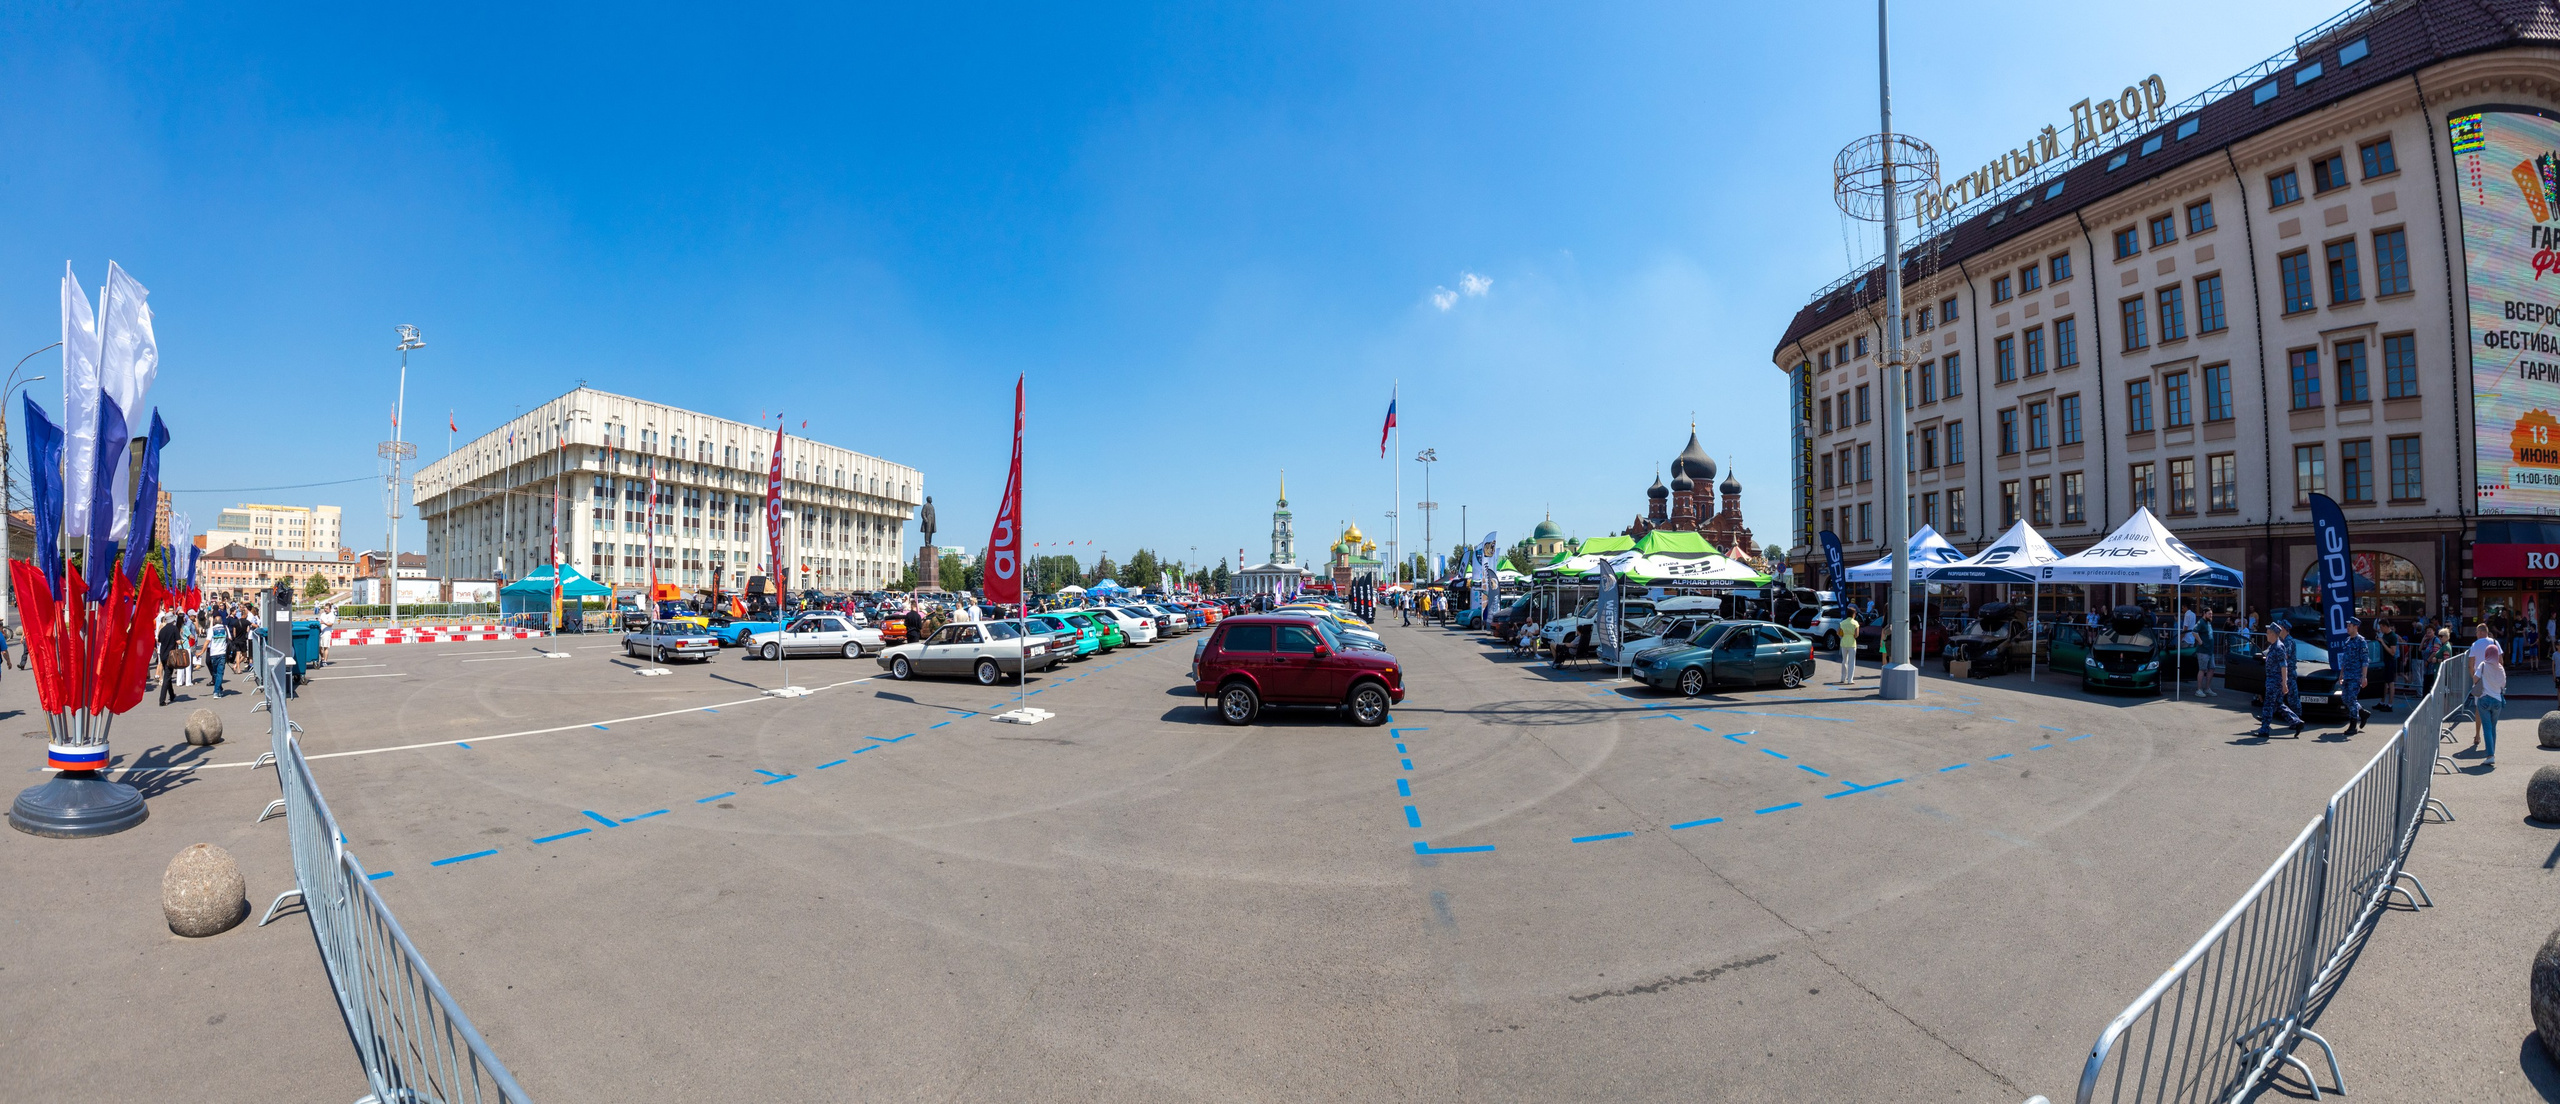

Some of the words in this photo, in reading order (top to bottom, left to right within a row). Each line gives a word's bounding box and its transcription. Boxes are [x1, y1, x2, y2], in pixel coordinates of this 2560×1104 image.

[1914, 123, 2059, 228] Гостиный
[2069, 73, 2167, 159] Двор
[2484, 330, 2560, 356] ФЕСТИВА
[2520, 361, 2560, 383] ГАРМ
[2530, 426, 2548, 445] 13
[2520, 447, 2559, 464] ИЮНЯ
[769, 450, 780, 583] to.ru
[2107, 534, 2123, 542] CAR
[2124, 533, 2150, 542] AUDIO
[2083, 547, 2149, 558] Pride
[2527, 552, 2560, 570] RO
[2072, 569, 2140, 577] www.pridecaraudio.com
[2324, 526, 2350, 636] Pride
